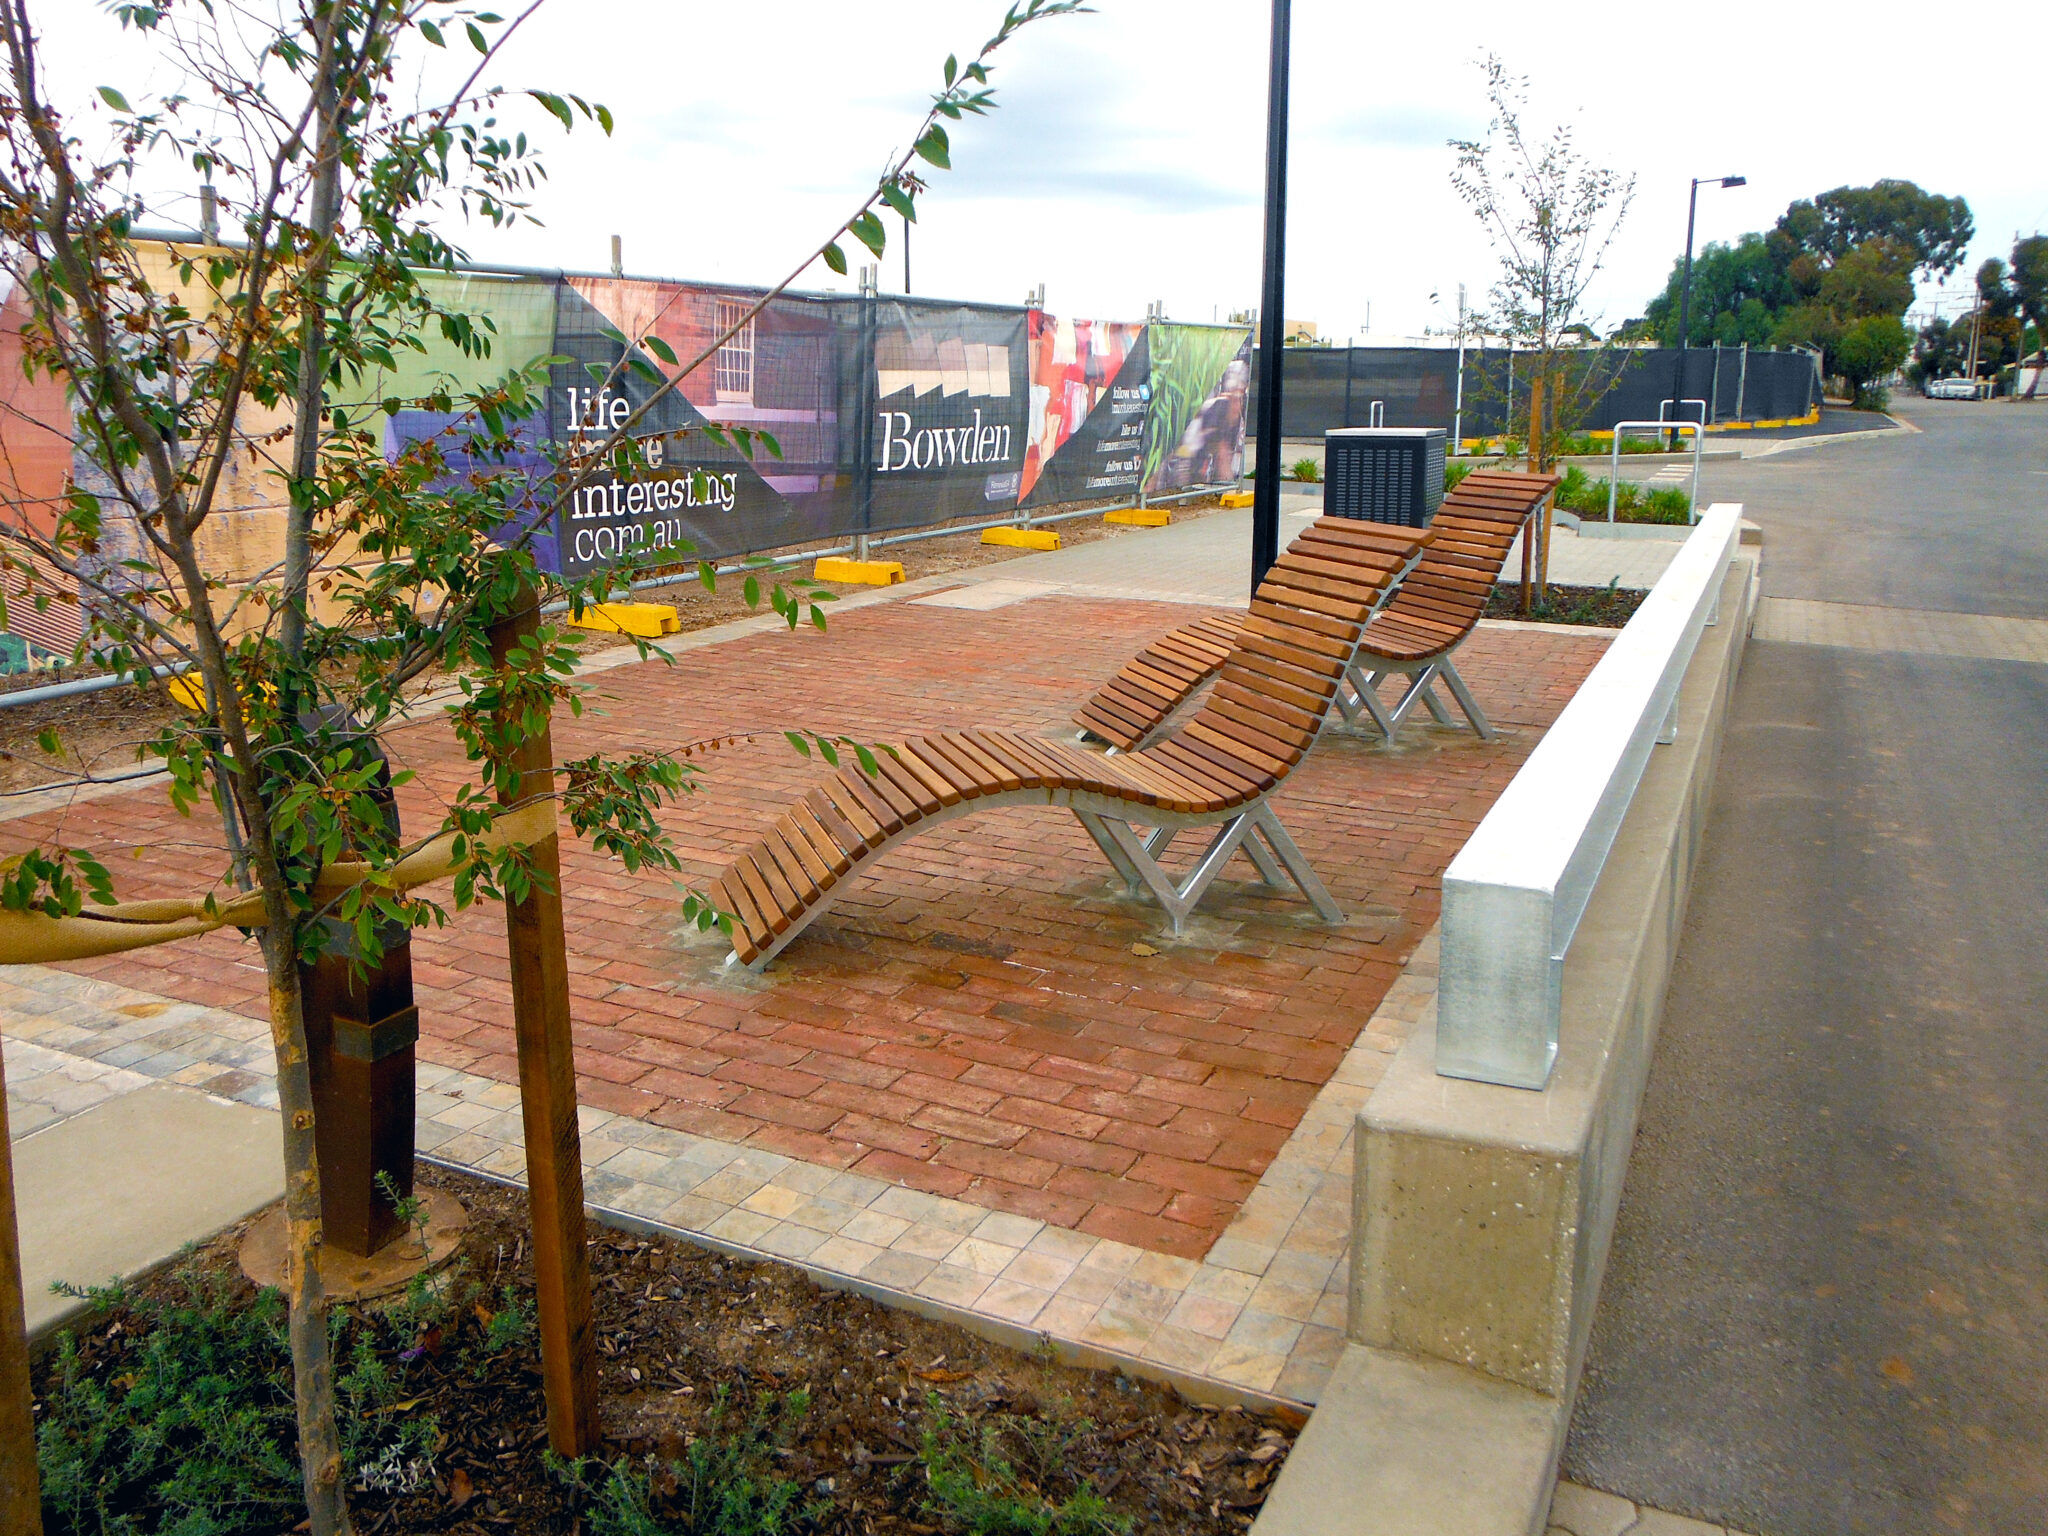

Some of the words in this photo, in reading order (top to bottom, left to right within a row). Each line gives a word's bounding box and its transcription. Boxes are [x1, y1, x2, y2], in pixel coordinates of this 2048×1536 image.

[567, 387, 630, 431] life
[1113, 386, 1130, 399] follow
[1131, 389, 1140, 399] us
[877, 409, 1011, 472] Bowden
[1105, 460, 1122, 472] follow
[1124, 460, 1133, 470] us
[568, 519, 682, 563] .com.au
